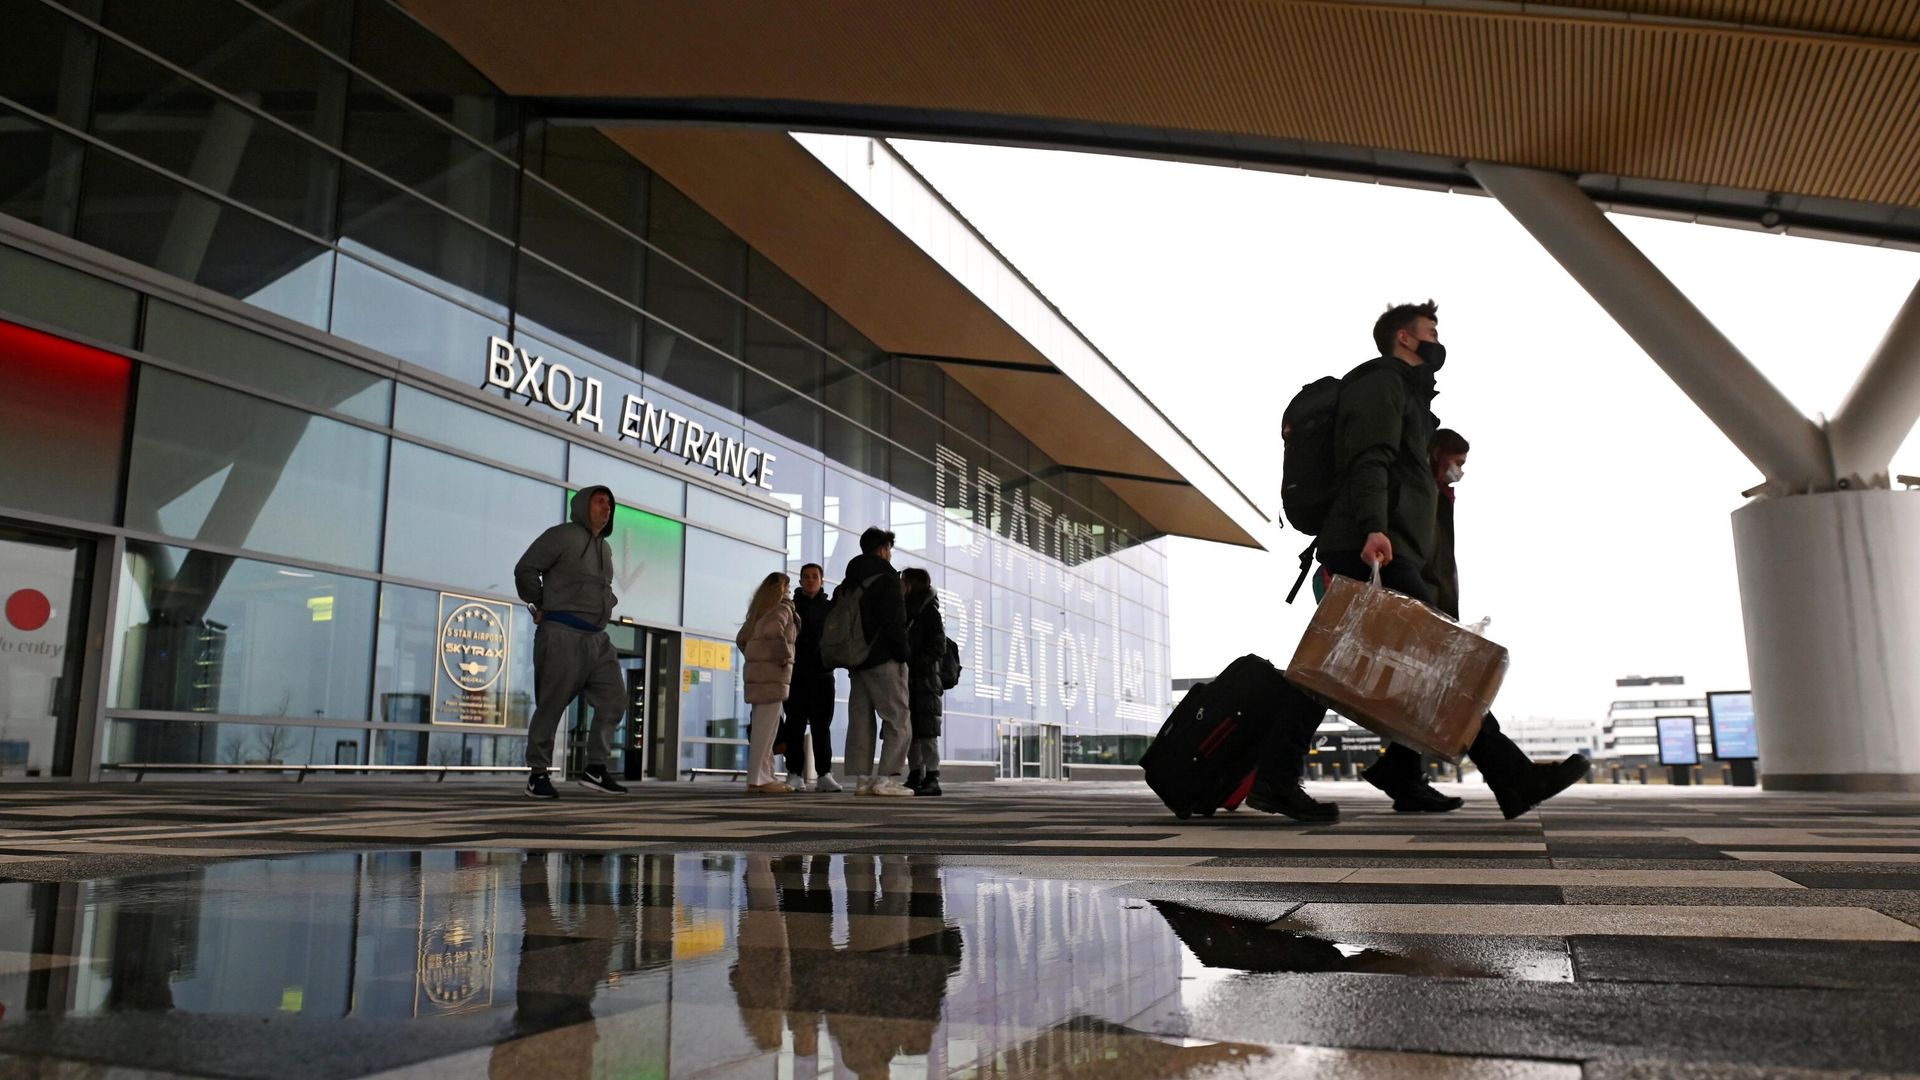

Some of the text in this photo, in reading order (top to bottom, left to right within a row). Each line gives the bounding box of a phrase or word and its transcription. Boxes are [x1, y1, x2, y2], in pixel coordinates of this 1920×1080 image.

[488, 336, 776, 489] ВХОД ENTRANCE
[453, 629, 472, 639] STAR
[473, 631, 503, 643] AIRPORT
[17, 640, 63, 658] entry
[445, 642, 503, 658] SKYTRAX
